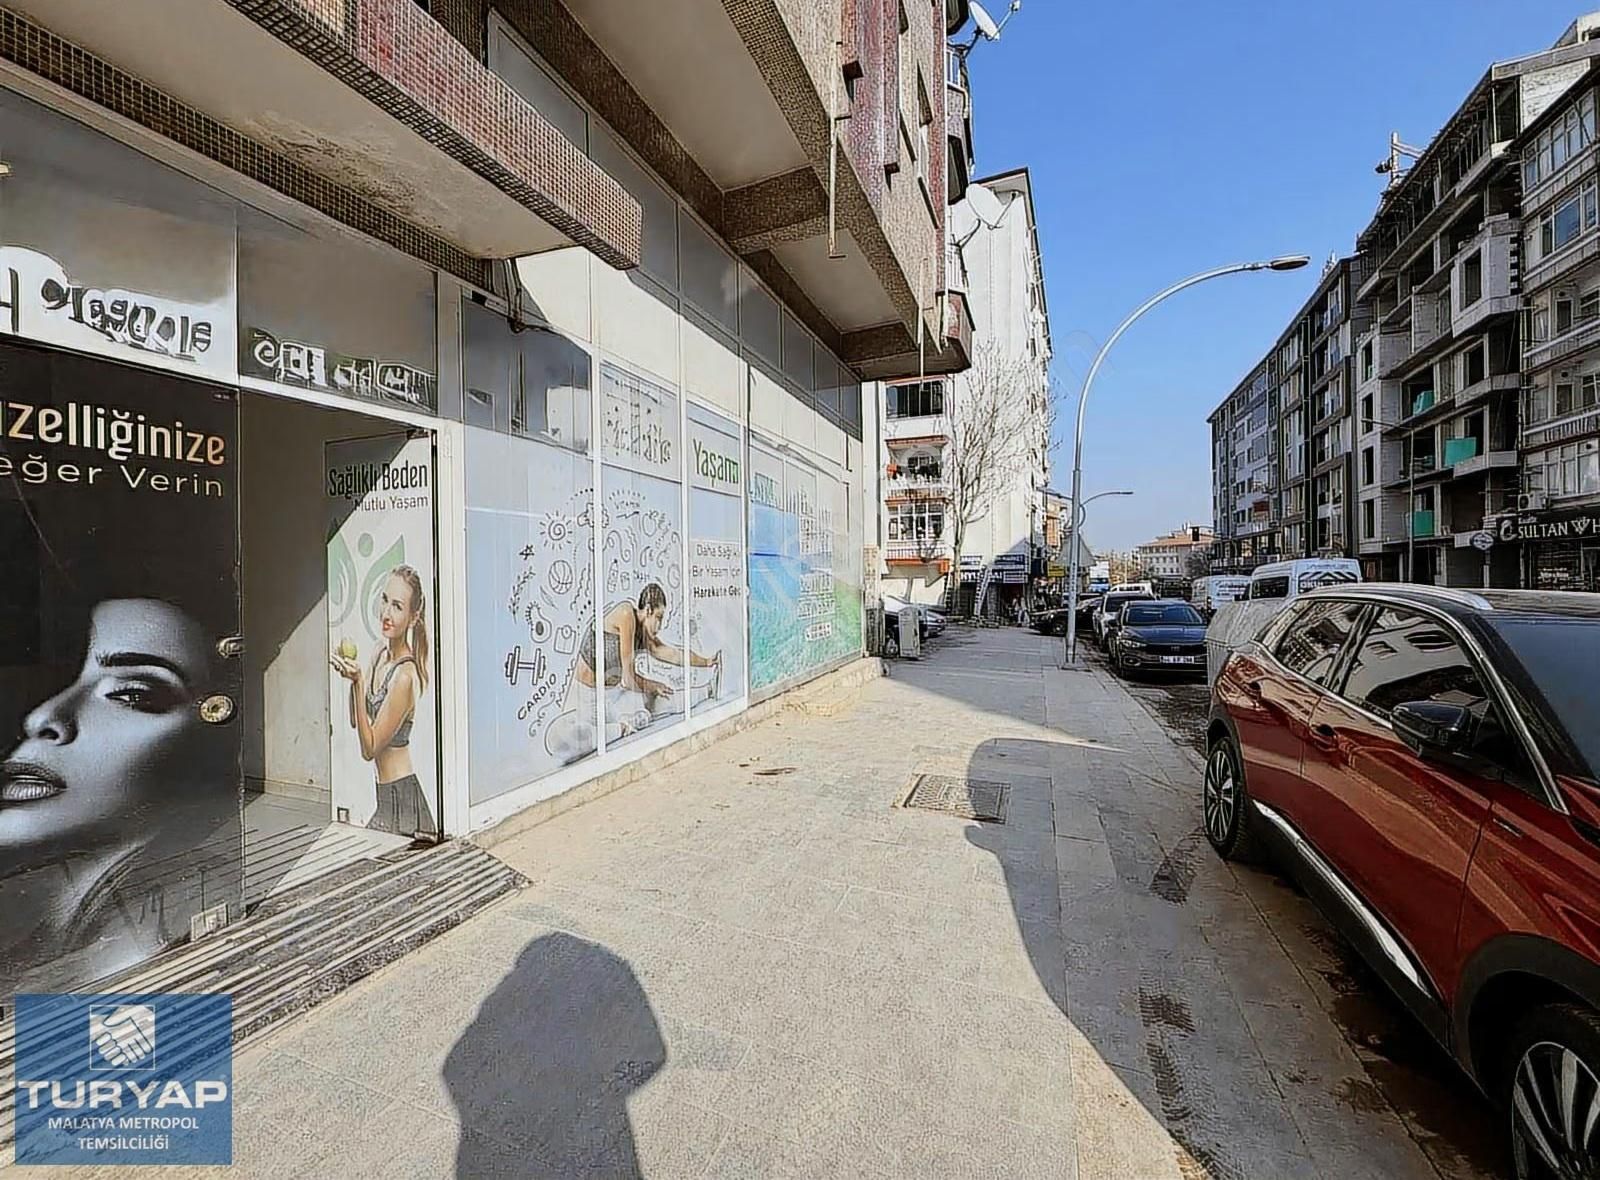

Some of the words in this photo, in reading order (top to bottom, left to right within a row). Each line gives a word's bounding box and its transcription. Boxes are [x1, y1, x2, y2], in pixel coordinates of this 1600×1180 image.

[0, 402, 225, 465] zelliğinize
[120, 464, 223, 497] Verin
[381, 460, 429, 491] Beden
[389, 496, 429, 509] Yaşam
[1518, 521, 1568, 539] SULTAN
[517, 673, 556, 720] CARDIO
